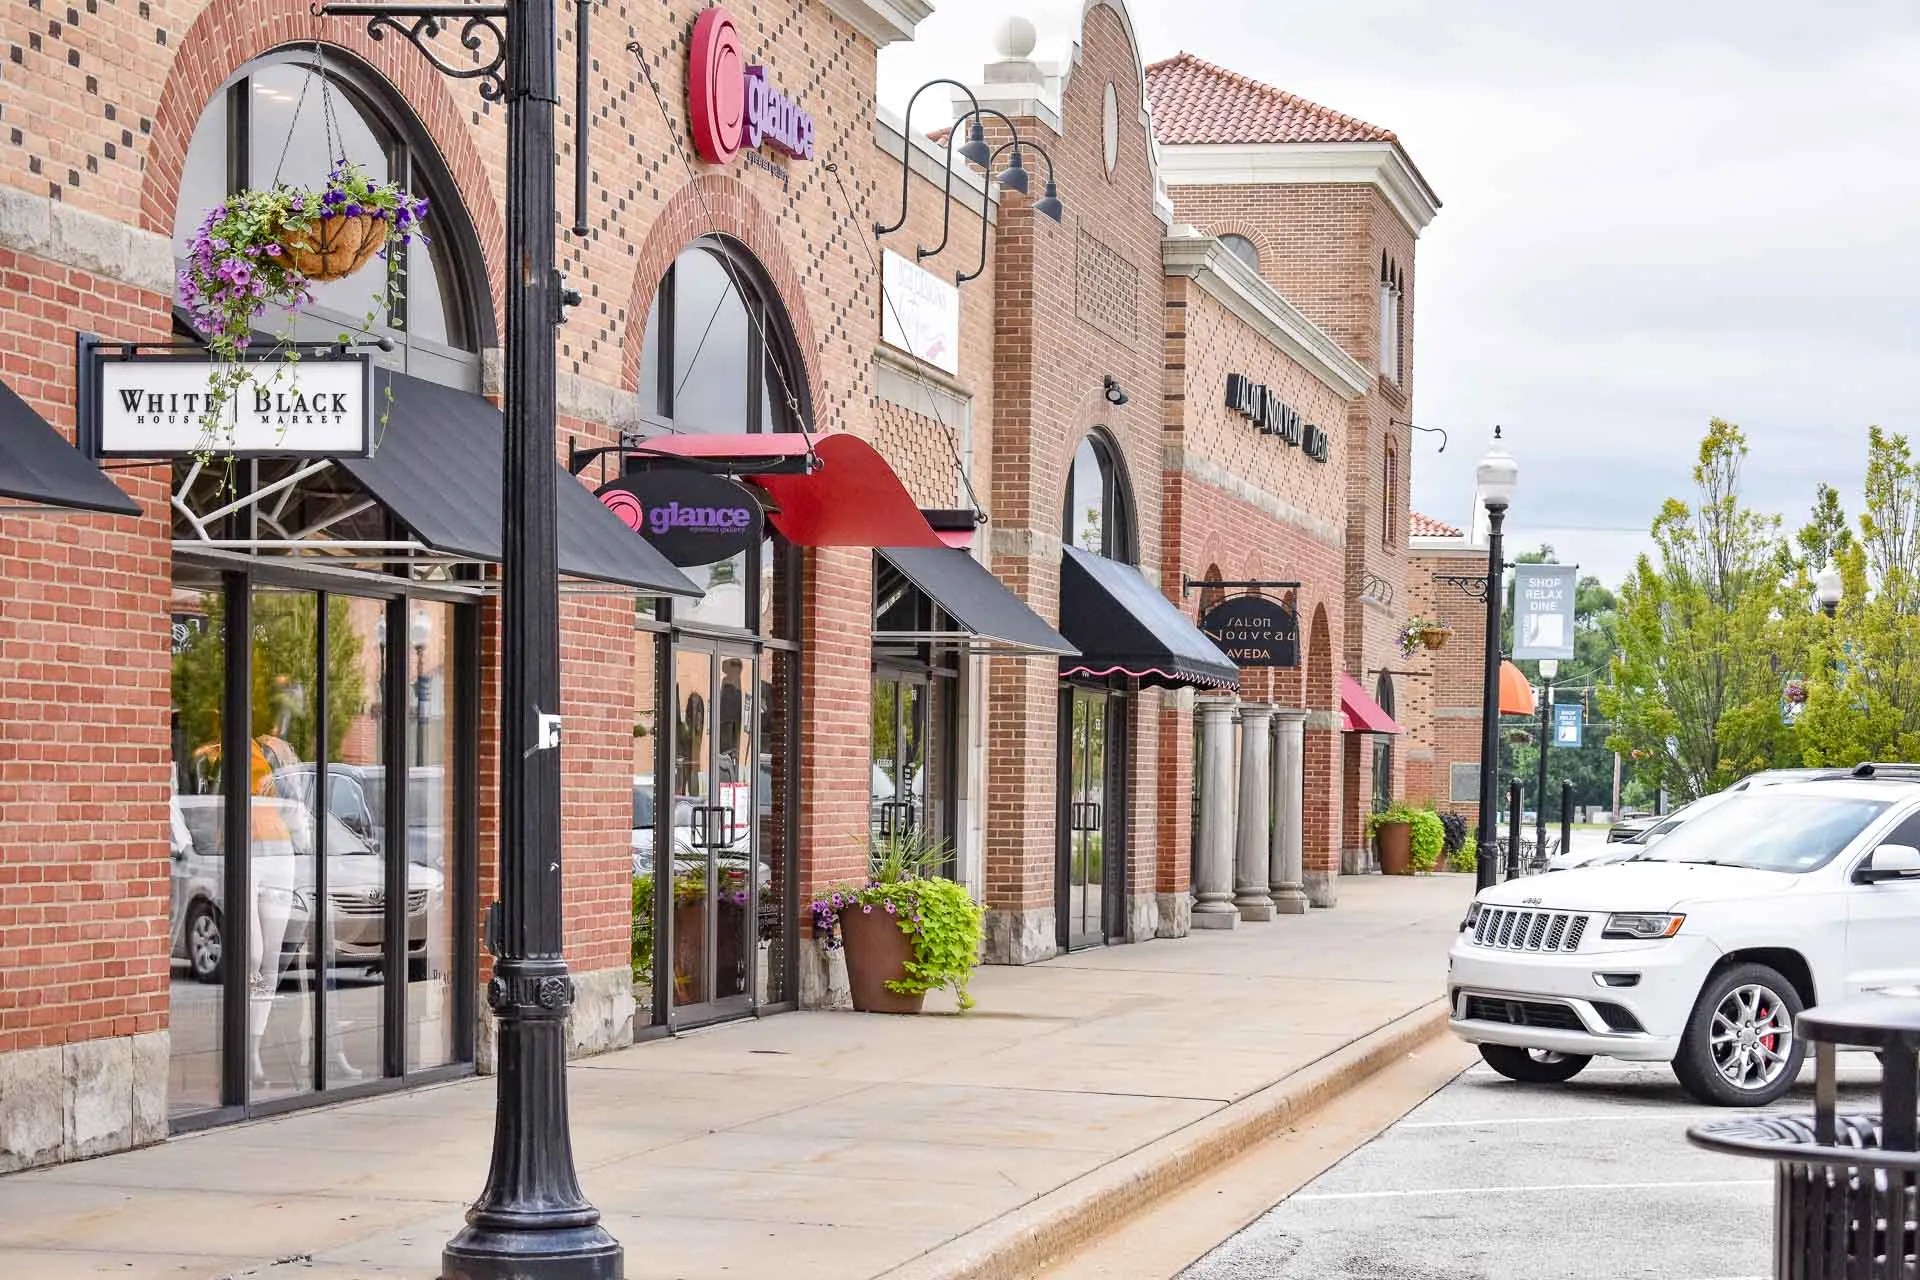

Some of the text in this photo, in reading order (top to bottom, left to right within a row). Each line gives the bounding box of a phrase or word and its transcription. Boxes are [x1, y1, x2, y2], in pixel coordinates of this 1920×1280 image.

[746, 65, 814, 161] glance
[119, 388, 348, 413] WHITE BLACK
[261, 415, 343, 425] MARKET
[650, 501, 750, 535] glance
[1529, 577, 1561, 589] SHOP
[1525, 589, 1563, 600] RELAX
[1530, 601, 1558, 611] DINE
[1226, 648, 1271, 659] AVEDA
